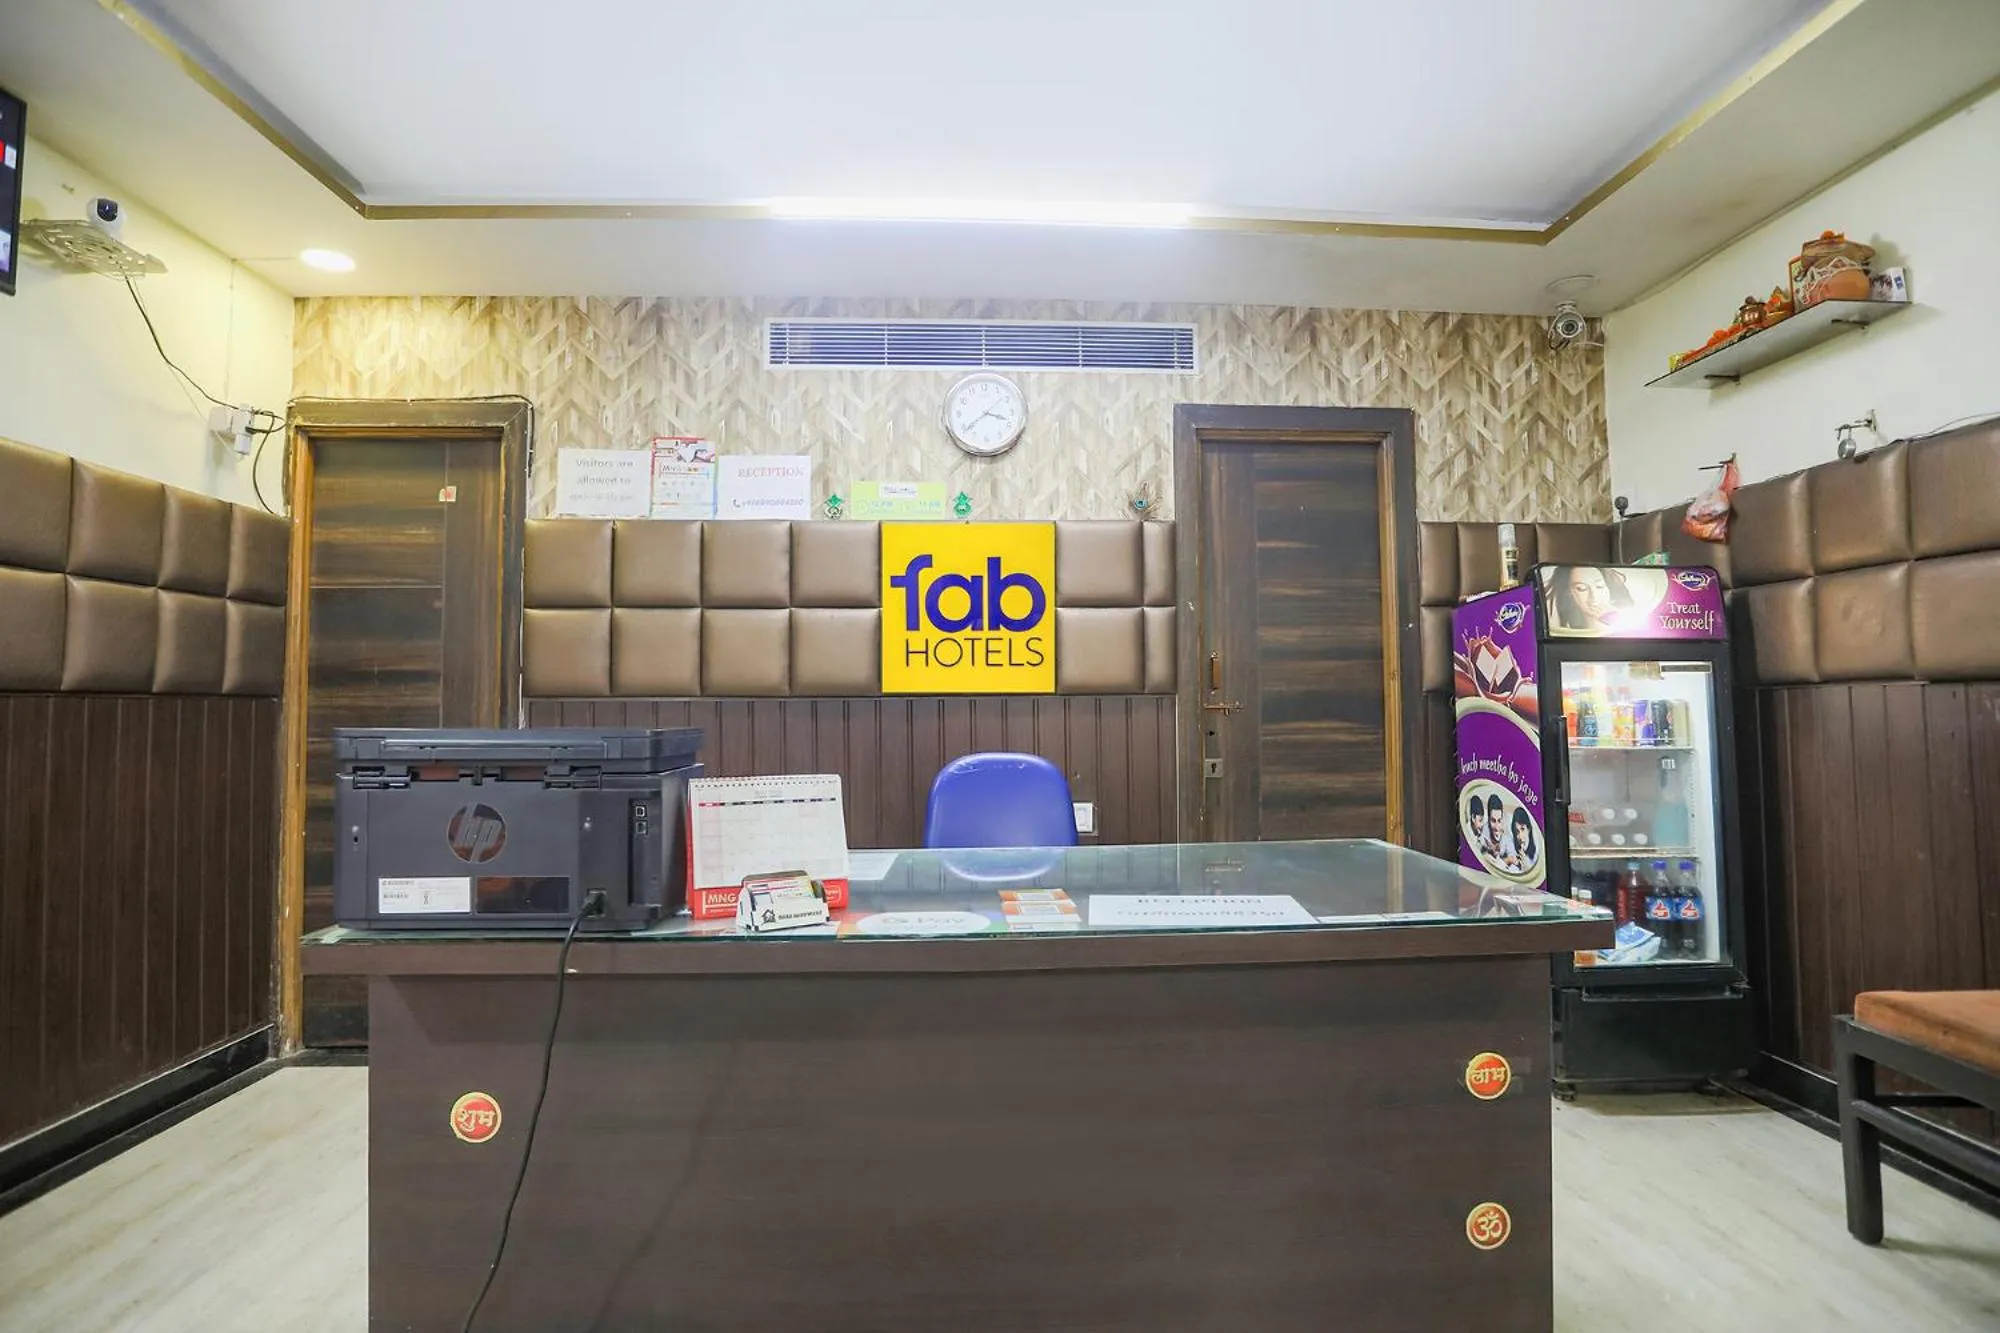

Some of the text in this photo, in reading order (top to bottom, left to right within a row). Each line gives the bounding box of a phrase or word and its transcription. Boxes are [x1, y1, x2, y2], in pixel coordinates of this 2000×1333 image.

[737, 467, 804, 478] RECEPTION
[890, 554, 1046, 632] fab
[1667, 602, 1701, 614] Treat
[1658, 610, 1715, 635] Yourself
[905, 637, 1045, 667] HOTELS
[1517, 775, 1539, 806] jaye
[707, 893, 736, 905] MNG
